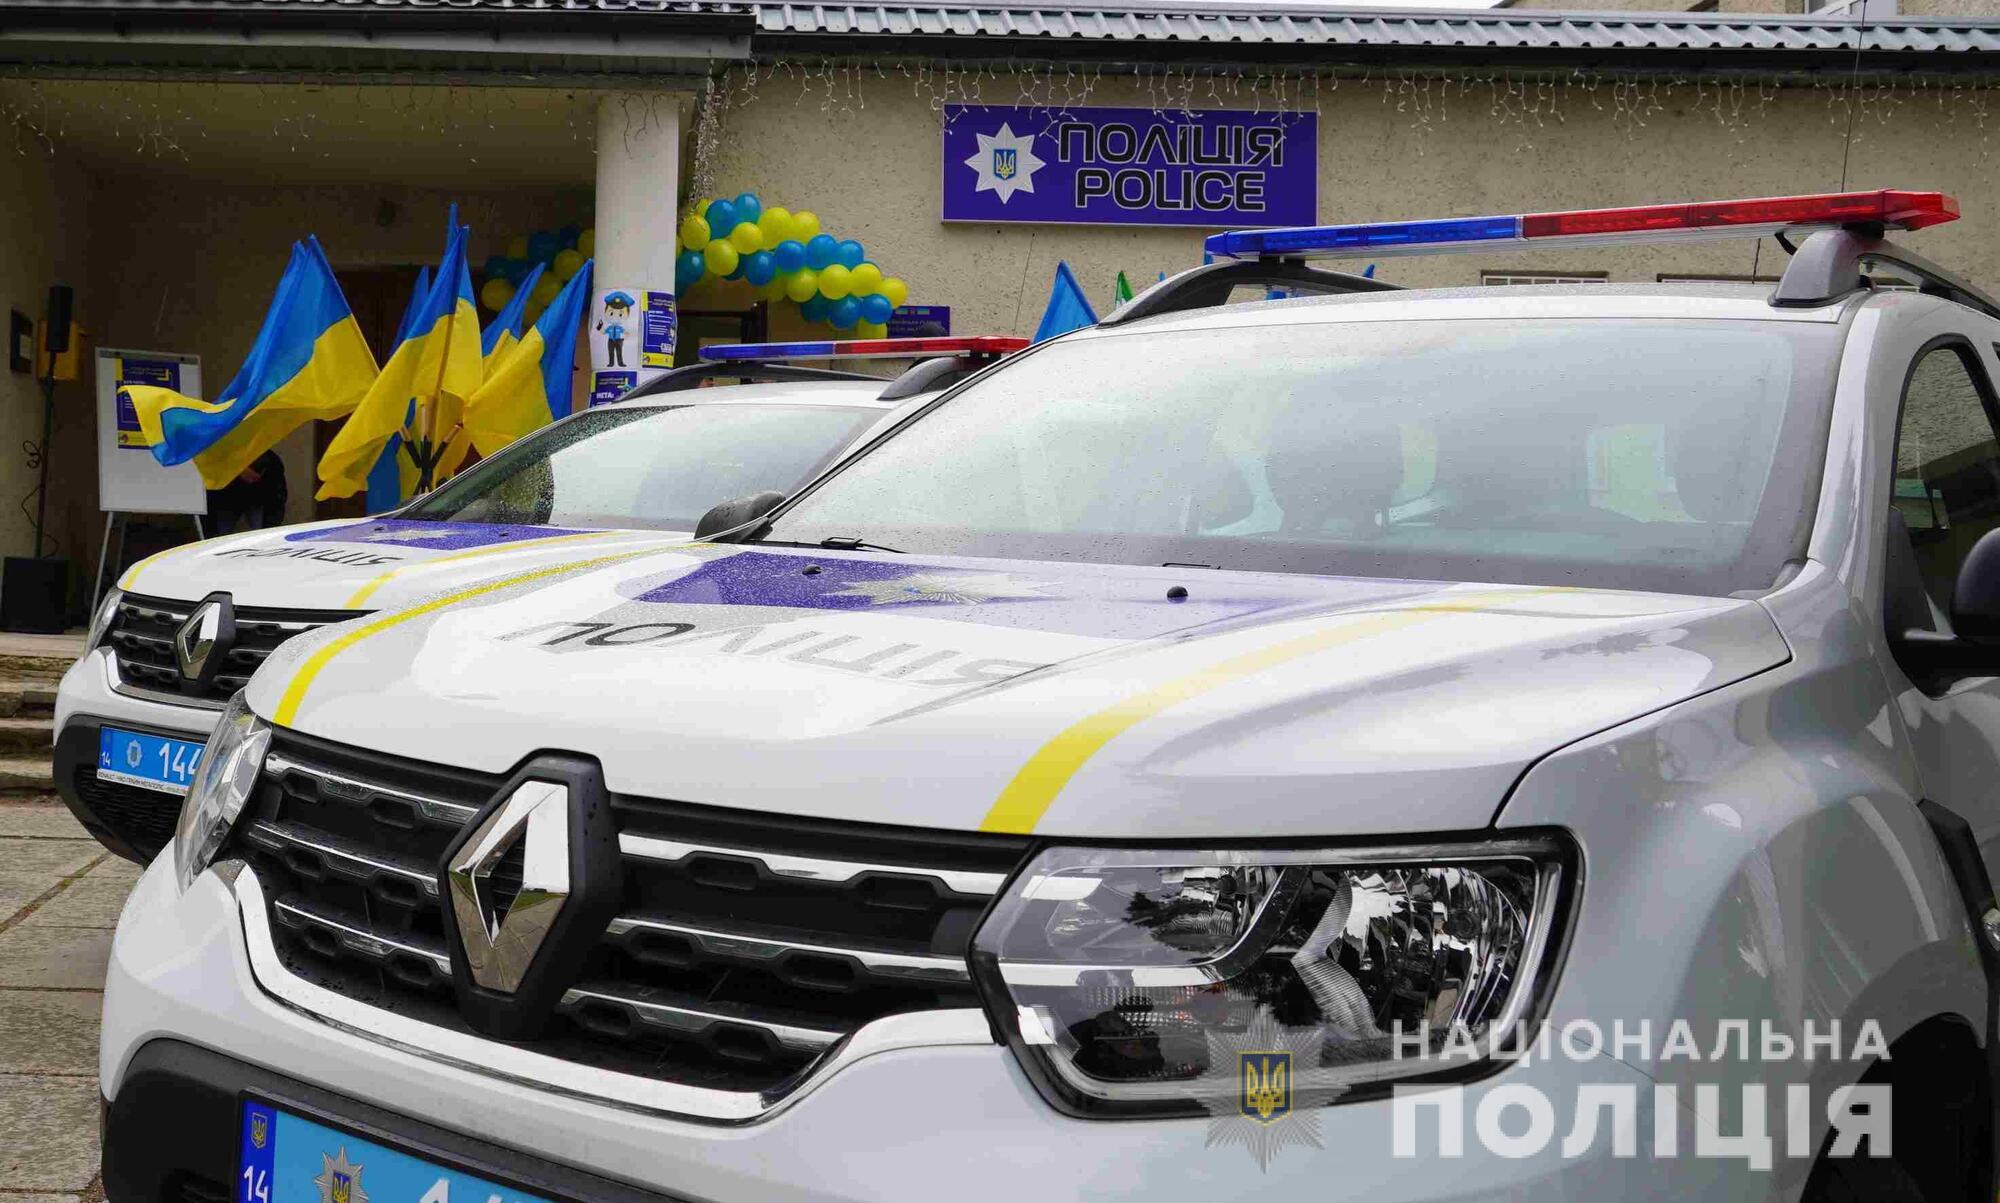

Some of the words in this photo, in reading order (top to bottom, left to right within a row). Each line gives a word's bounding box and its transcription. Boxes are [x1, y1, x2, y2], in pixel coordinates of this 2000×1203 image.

[1058, 122, 1284, 167] ПОЛІЦІЯ
[1075, 168, 1266, 212] POLICE
[501, 621, 1058, 688] ПОЛІЦІЯ
[101, 751, 111, 767] 14
[243, 1165, 269, 1203] 14
